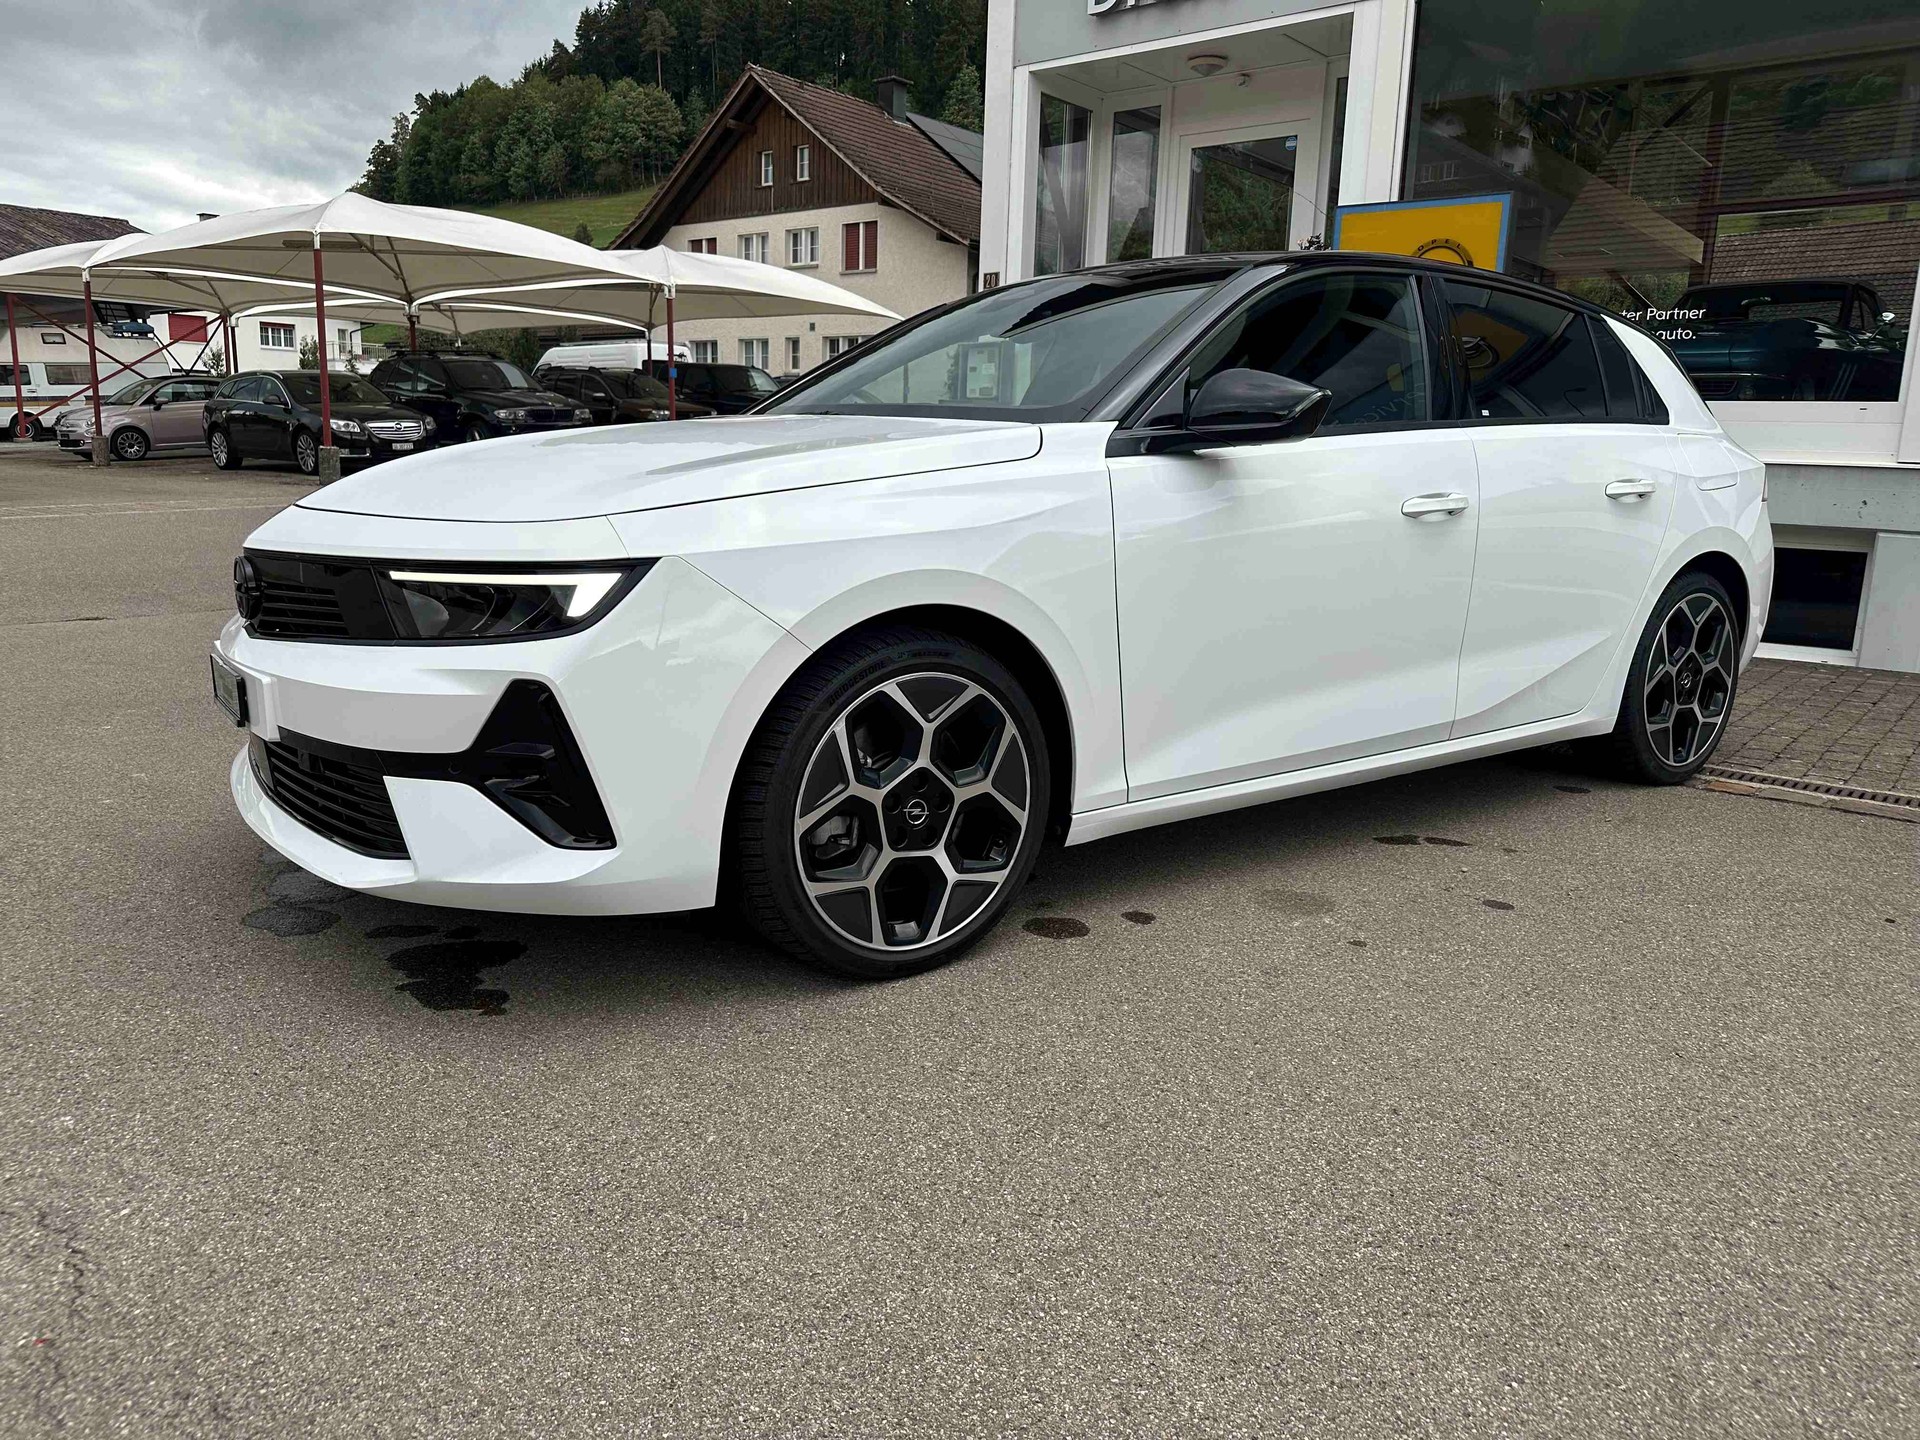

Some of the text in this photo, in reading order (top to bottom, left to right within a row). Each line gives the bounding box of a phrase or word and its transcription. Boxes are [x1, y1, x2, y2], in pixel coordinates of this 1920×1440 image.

[1417, 238, 1462, 252] OPEL
[986, 274, 996, 288] 20
[1619, 307, 1706, 321] ter Partner
[1653, 327, 1697, 340] auto.
